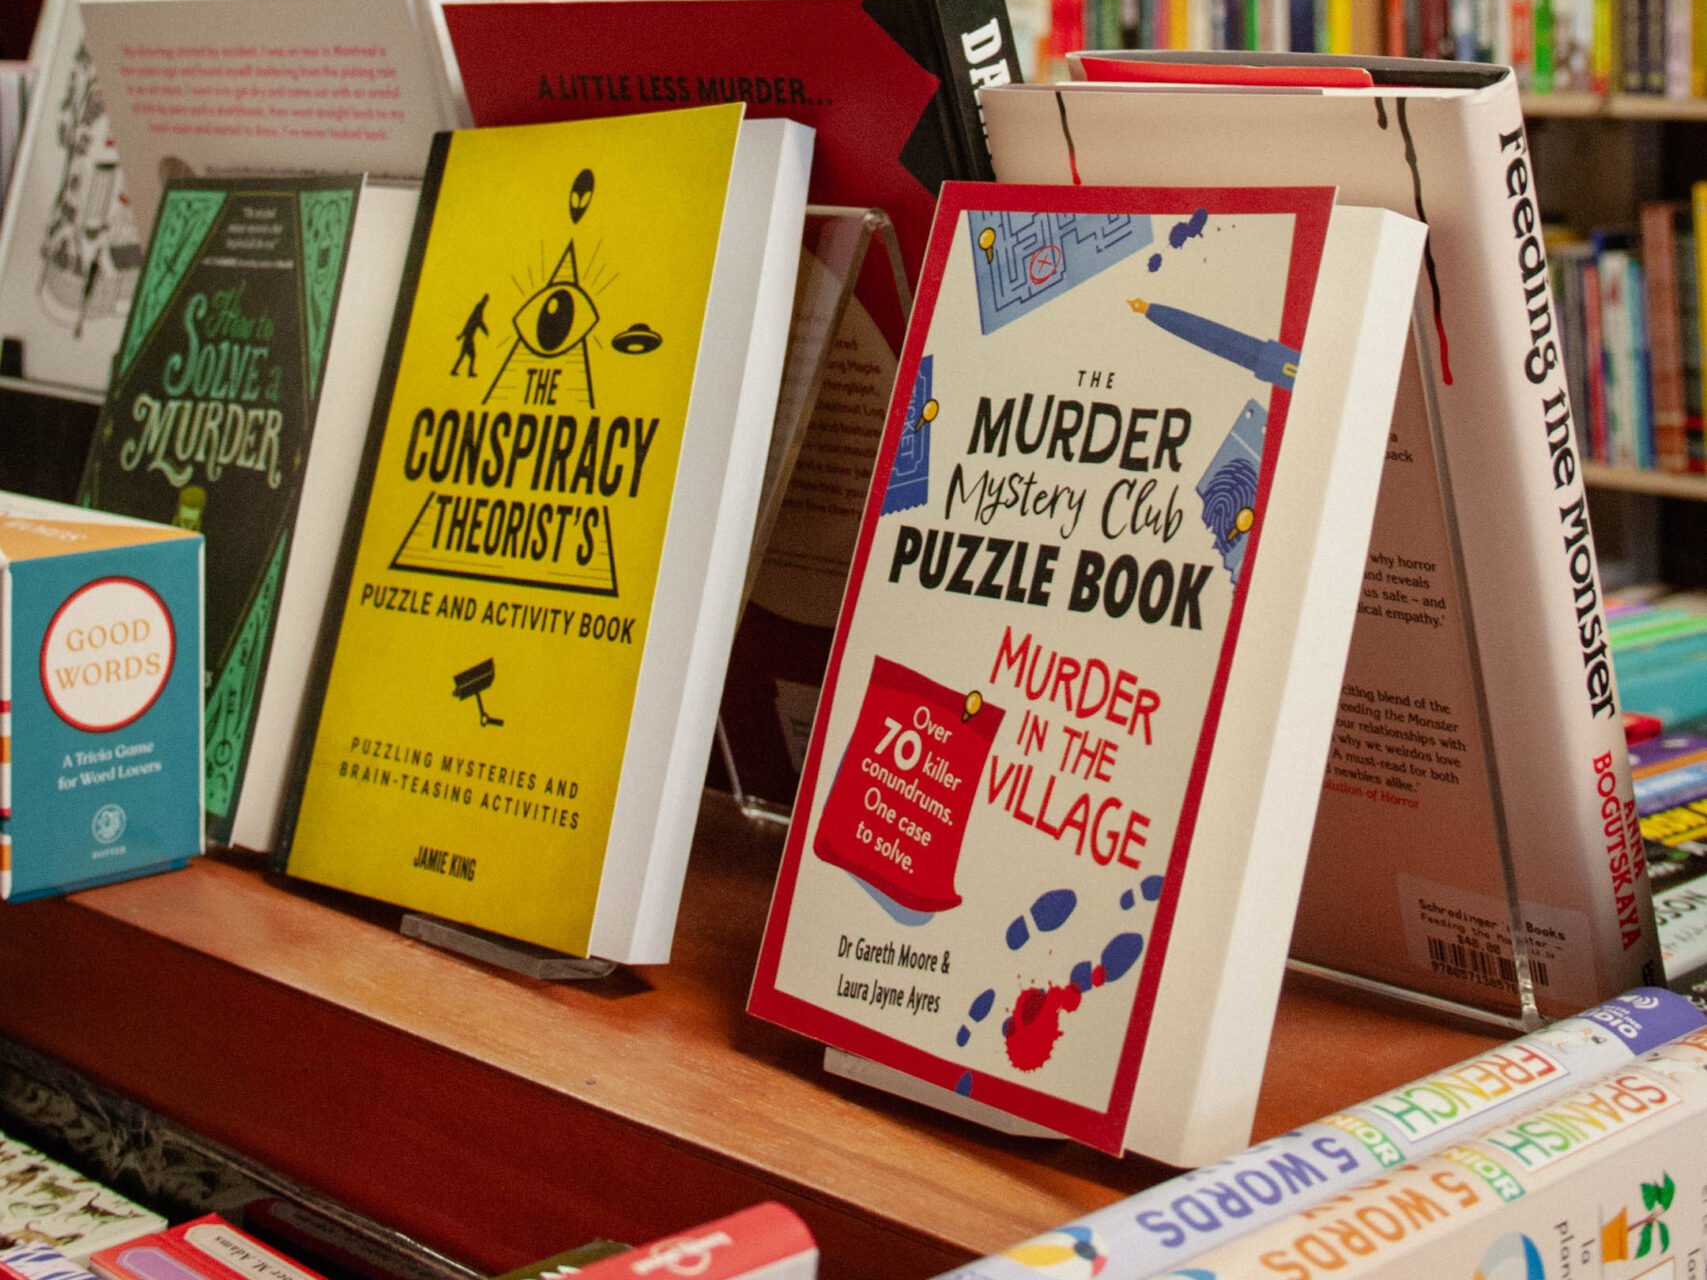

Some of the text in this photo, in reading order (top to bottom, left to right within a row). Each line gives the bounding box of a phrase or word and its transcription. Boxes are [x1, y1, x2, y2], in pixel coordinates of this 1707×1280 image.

[538, 74, 832, 105] A LITTLE LESS MURDER...
[163, 293, 269, 401] SOLVE
[523, 368, 562, 406] THE
[1078, 370, 1115, 390] THE
[121, 393, 284, 489] MURDER
[403, 407, 660, 498] CONSPIRACY
[967, 392, 1191, 472] MURDER
[945, 463, 1184, 543] Mystery Club
[430, 494, 600, 567] THEORIST'S
[1369, 552, 1437, 573] why horror
[1541, 388, 1576, 491] the
[1559, 496, 1616, 721] Monster
[888, 525, 1213, 630] PUZZLE BOOK
[1386, 573, 1430, 589] reveals
[360, 583, 637, 645] PUZZLE AND ACTIVITY BOOK
[1382, 589, 1408, 604] safe
[1422, 595, 1446, 609] and
[66, 618, 151, 653] GOOD
[55, 652, 161, 691] WORDS
[990, 625, 1161, 746] MURDER
[1340, 702, 1459, 733] eeding the Monster
[1378, 690, 1410, 708] blend
[1414, 697, 1427, 710] of
[1430, 700, 1451, 715] the
[913, 705, 952, 745] Over
[1016, 710, 1119, 782] IN THE
[1358, 720, 1436, 747] relationships
[1439, 737, 1467, 752] with
[63, 741, 155, 769] A Trivia Game
[351, 736, 579, 799] PUZZLING MYSTERIES AND
[874, 717, 962, 792] 70 killer
[1338, 733, 1462, 768] why we weirdos love
[1345, 751, 1407, 774] must-read
[1409, 763, 1427, 778] for
[1430, 768, 1460, 785] both
[58, 759, 162, 791] for Word Lovers
[339, 761, 580, 830] BRAIN-TEASING ACTIVITIES
[861, 756, 953, 827] conundrums.
[1334, 765, 1382, 785] newbies
[864, 787, 931, 847] One case
[988, 755, 1151, 870] VILLAGE
[1381, 791, 1419, 809] Horror
[855, 820, 914, 874] to solve.
[1593, 749, 1642, 953] BOGUTSKAYA
[1623, 799, 1648, 880] ANNA
[413, 845, 477, 882] JAMIE KING
[1525, 921, 1566, 942] Books
[837, 933, 951, 975] Dr Gareth Moore &
[837, 973, 941, 1015] Laura Jayne Ayres
[1373, 1045, 1557, 1135] FRENCH
[1489, 1075, 1668, 1167] SPANISH
[1312, 1136, 1360, 1174] 5
[1135, 1151, 1328, 1250] WORDS
[1431, 1171, 1480, 1209] 5
[215, 1236, 250, 1261] Adams
[1258, 1187, 1450, 1280] WORDS
